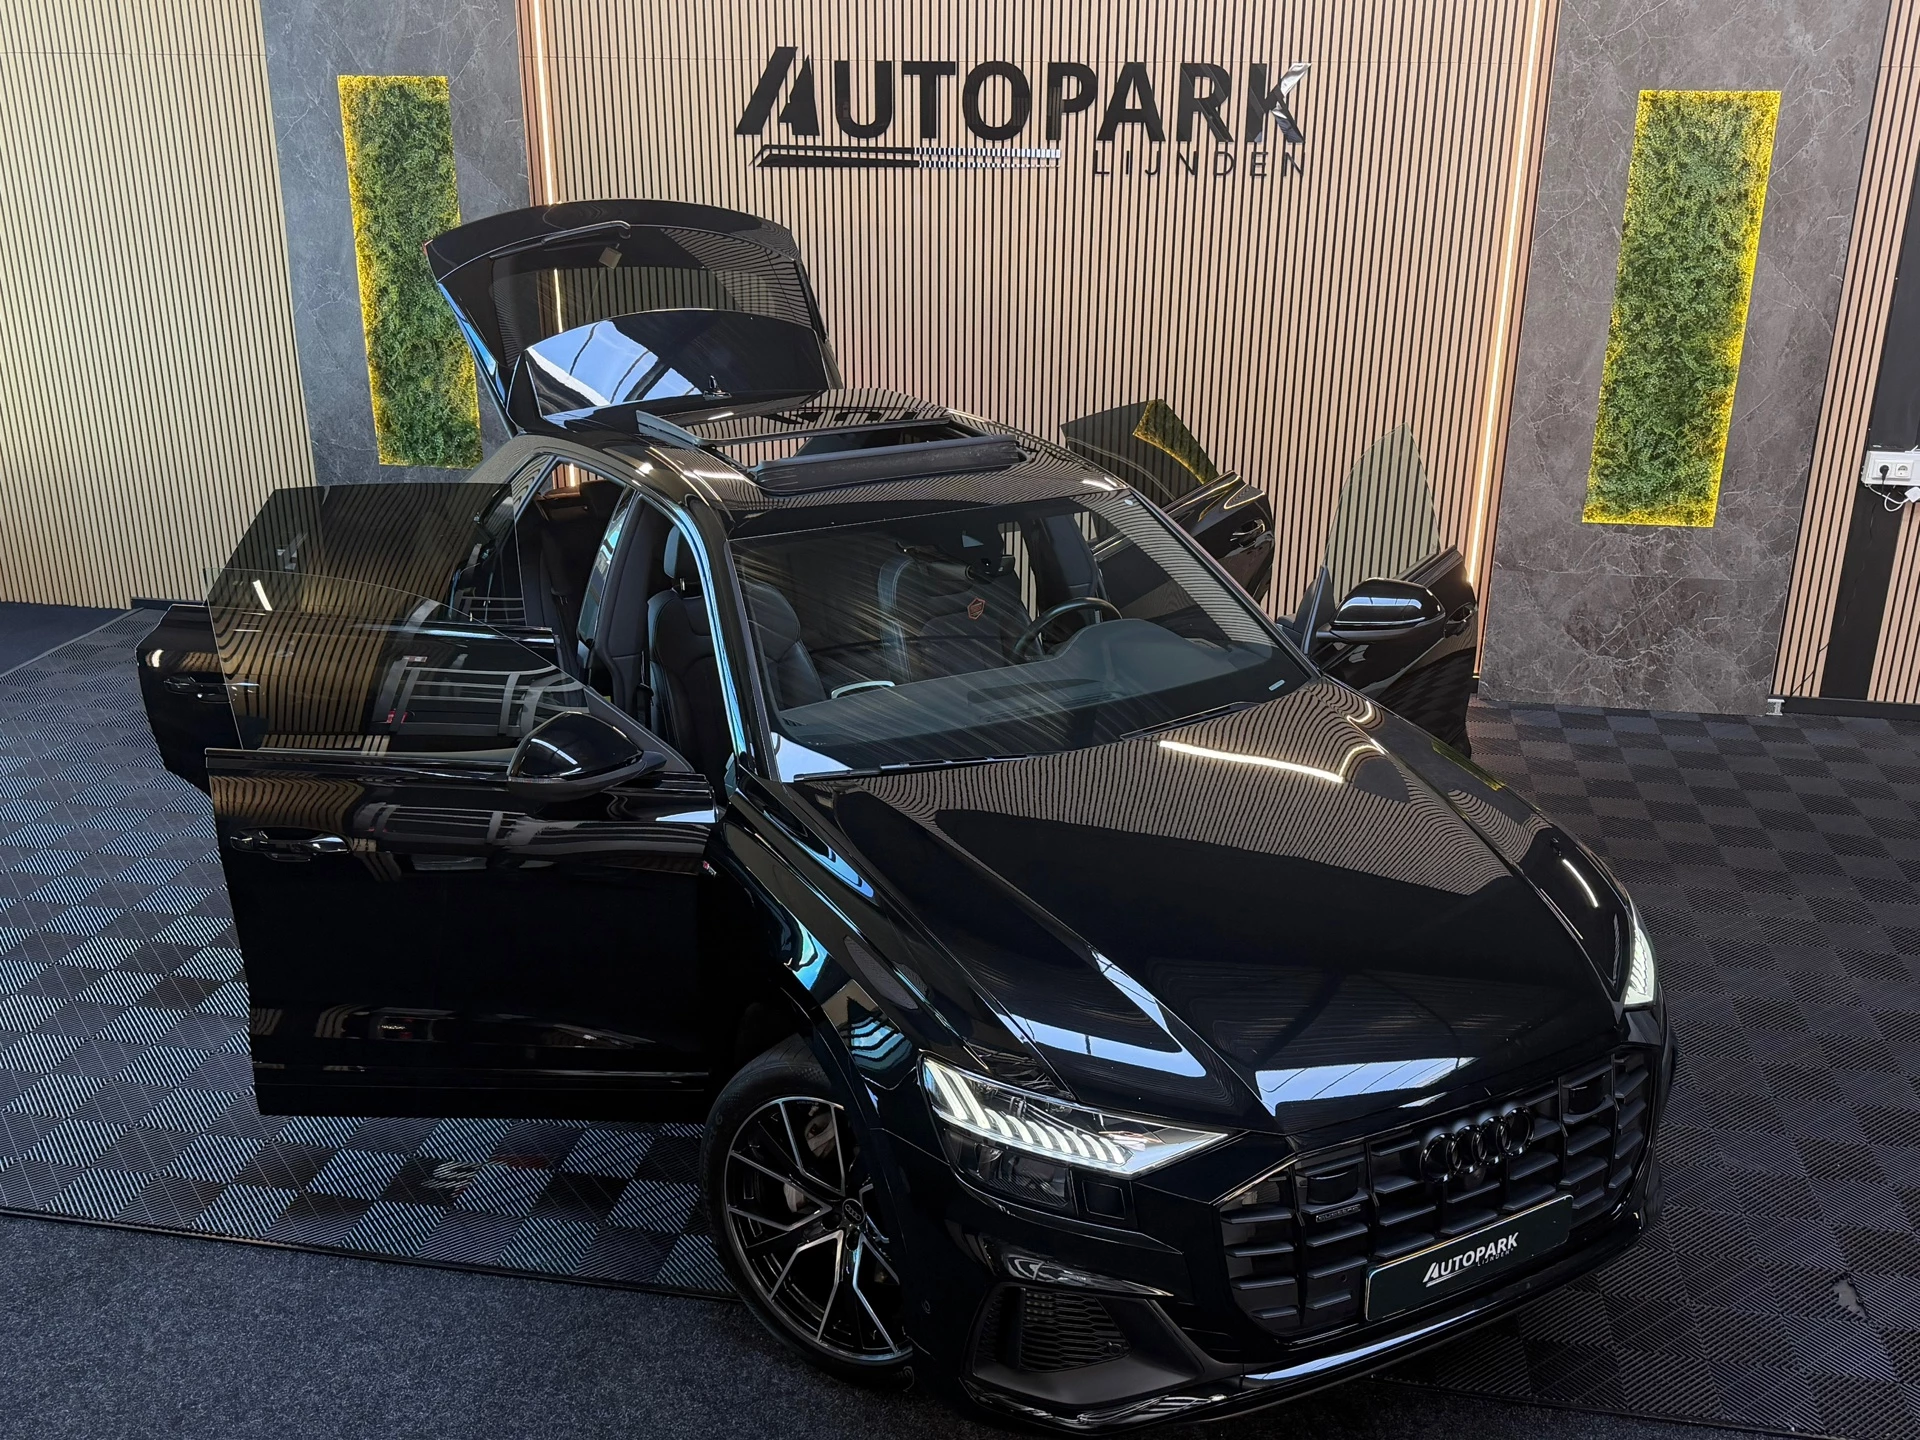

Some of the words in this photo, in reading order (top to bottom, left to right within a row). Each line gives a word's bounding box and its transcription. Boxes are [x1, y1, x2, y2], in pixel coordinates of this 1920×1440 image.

[735, 46, 1312, 143] AUTOPARK
[1092, 149, 1306, 178] LIJNDEN
[1422, 1232, 1519, 1283] AUTOPARK
